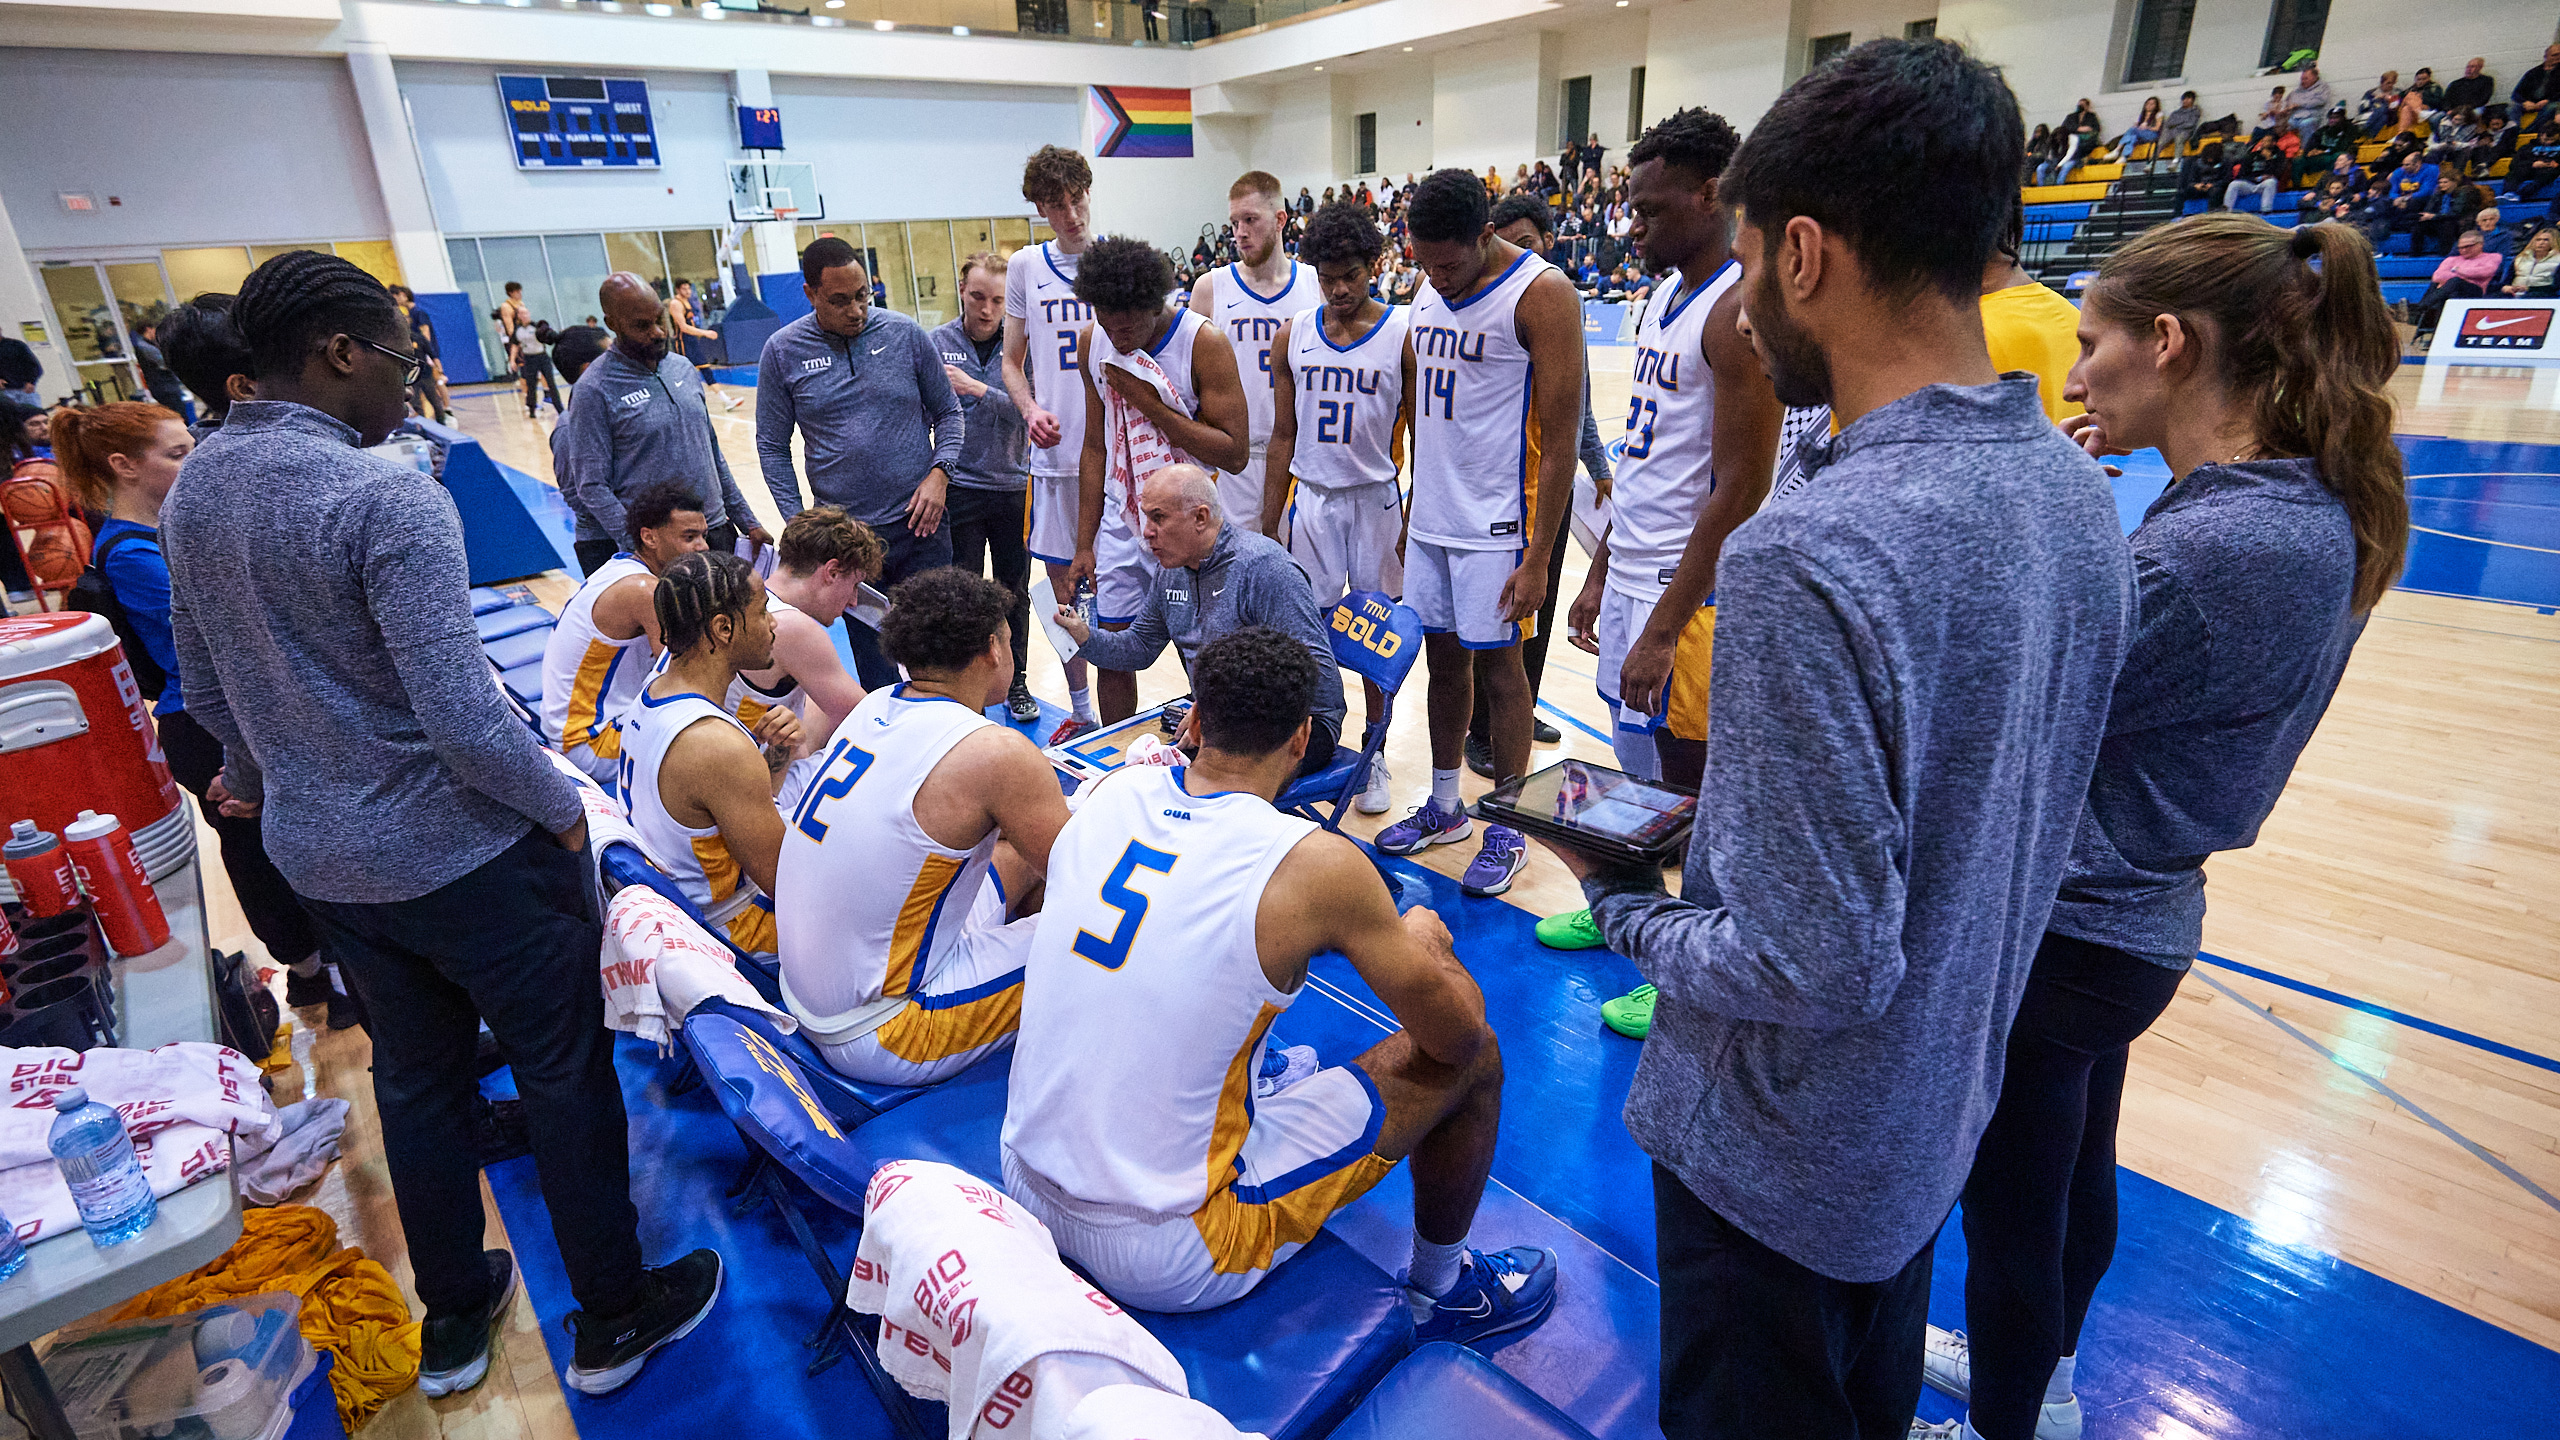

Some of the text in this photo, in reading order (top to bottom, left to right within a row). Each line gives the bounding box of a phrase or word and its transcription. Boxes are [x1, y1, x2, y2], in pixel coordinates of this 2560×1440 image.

[614, 102, 642, 113] GUEST
[1040, 298, 1094, 323] TM
[1231, 317, 1293, 341] TM
[2465, 336, 2533, 347] TEAM
[942, 351, 967, 361] TMU
[1415, 325, 1486, 363] TMU
[802, 356, 832, 370] TMU
[1301, 365, 1381, 395] TMU
[620, 388, 651, 405] TMU
[1425, 366, 1456, 421] 14
[1318, 400, 1355, 445] 21
[1165, 589, 1189, 601] TMU
[1362, 598, 1392, 622] TMU
[1331, 605, 1402, 659] BOLD
[791, 736, 877, 846] 12
[1163, 808, 1191, 821] OUA
[1070, 836, 1181, 973] 5
[10, 1073, 79, 1092] STEEL
[914, 1249, 967, 1318] BIO
[932, 1279, 973, 1329] STEEL
[983, 1371, 1033, 1429] BIO
